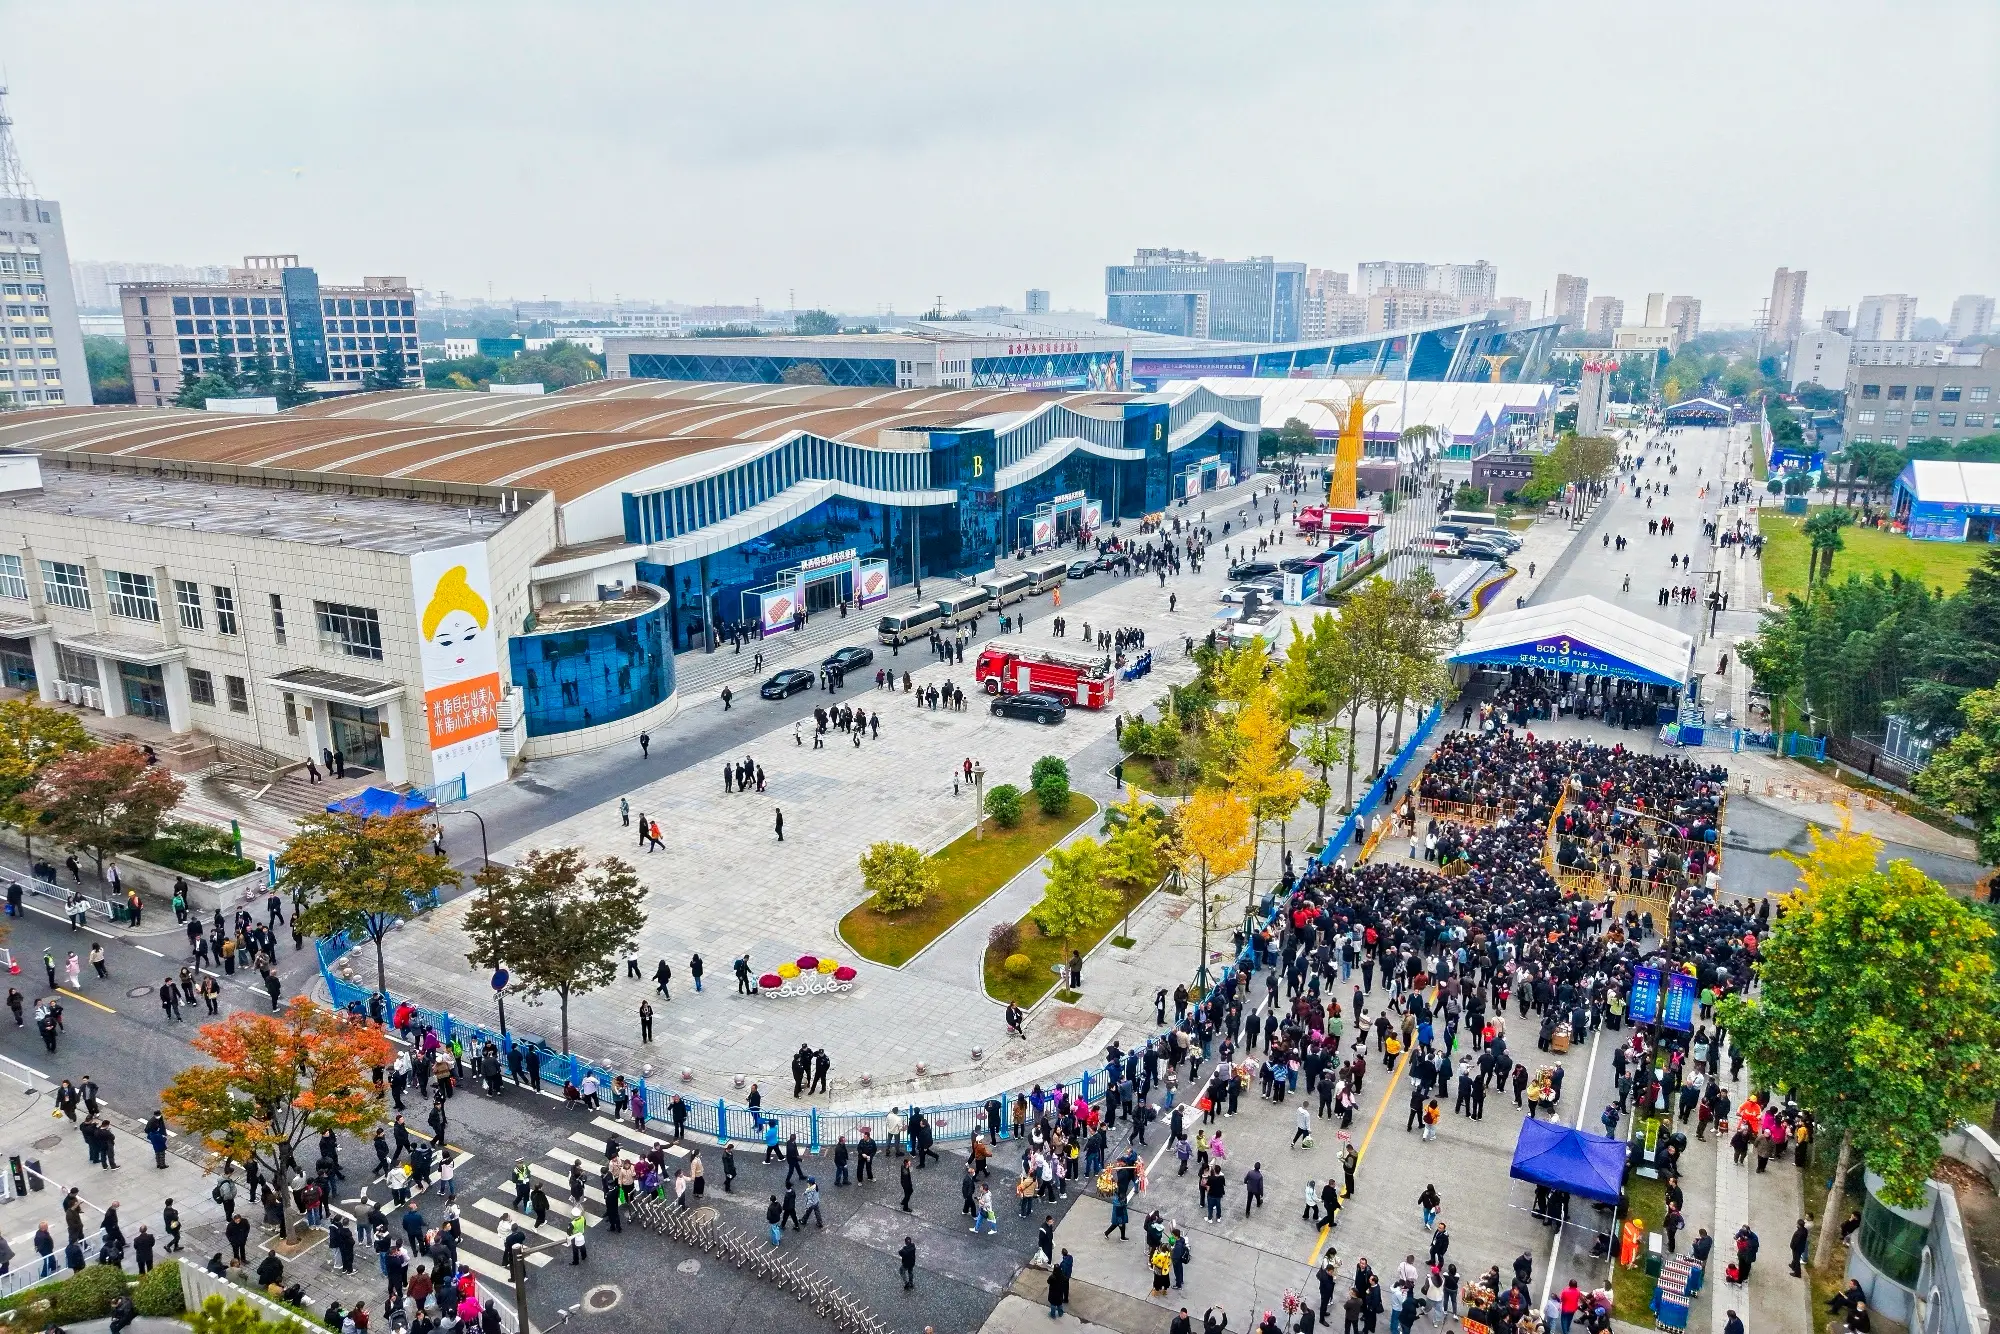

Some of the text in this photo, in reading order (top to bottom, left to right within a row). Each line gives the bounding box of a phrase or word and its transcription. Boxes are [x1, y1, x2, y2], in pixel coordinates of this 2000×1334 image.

[1155, 423, 1162, 441] B
[973, 455, 983, 478] B
[1536, 645, 1557, 654] BCD
[1559, 640, 1570, 655] 3
[1519, 653, 1556, 665] 证件入口
[1571, 659, 1609, 672] 门票入口
[433, 685, 496, 719] 米脂自古出美人
[434, 703, 497, 737] 米脂小米更养人
